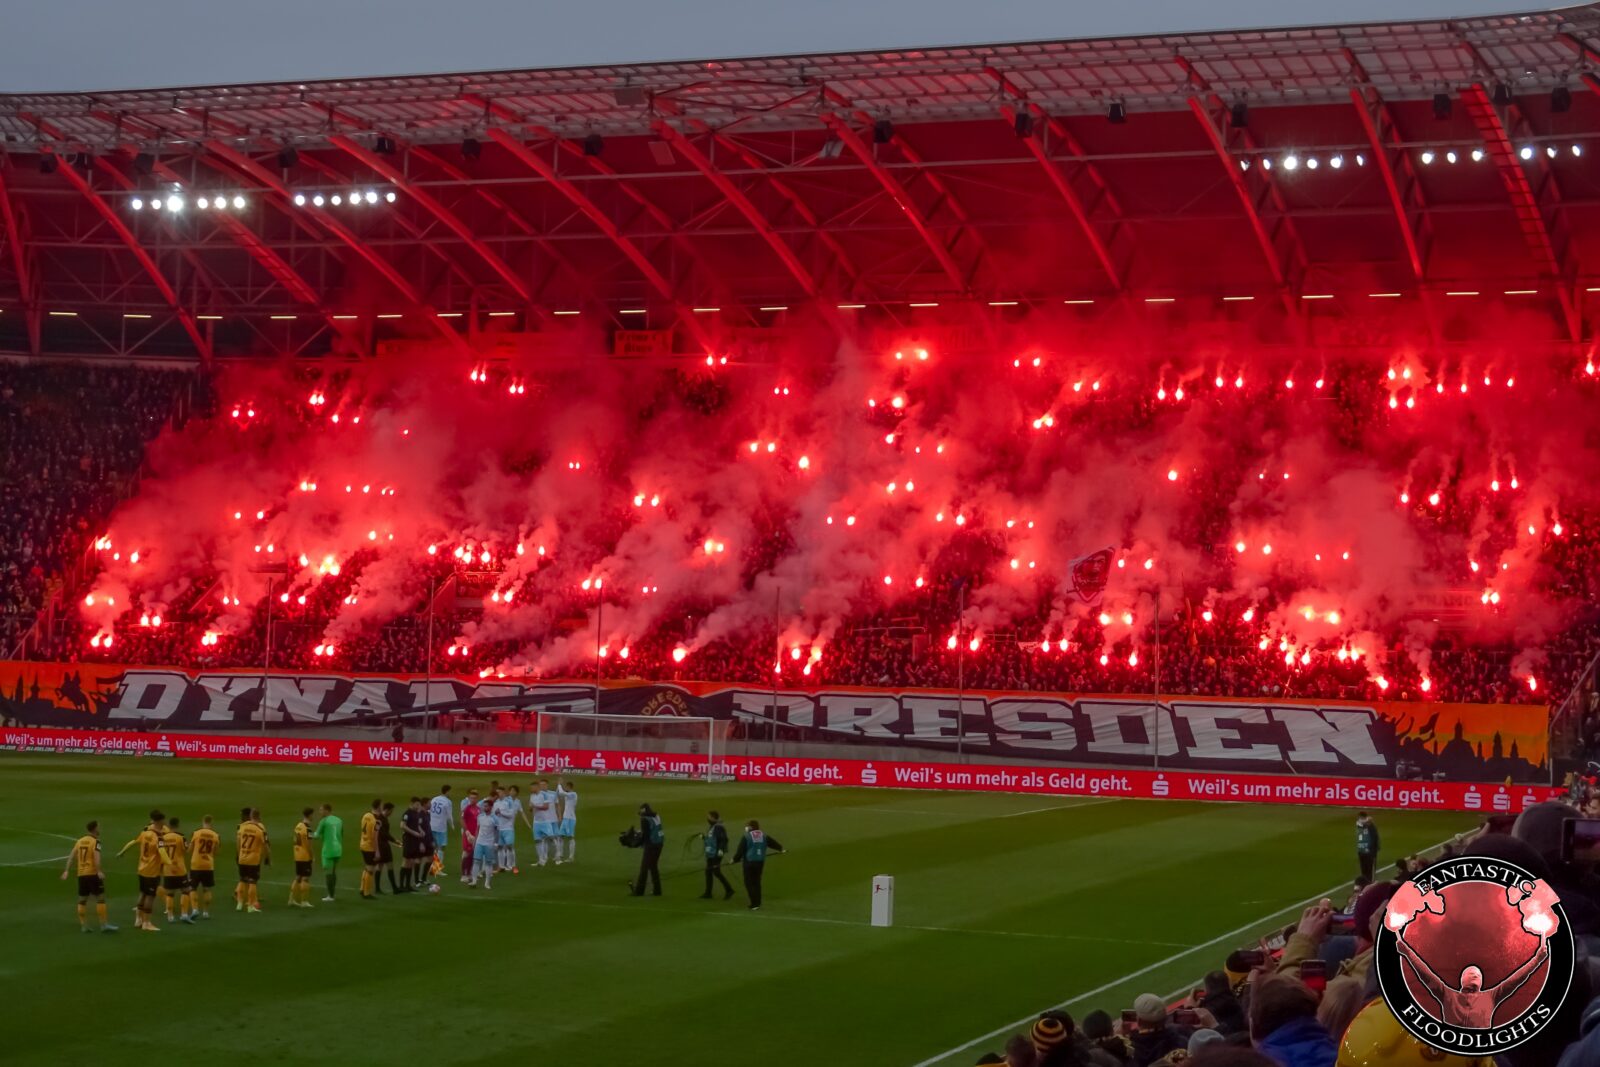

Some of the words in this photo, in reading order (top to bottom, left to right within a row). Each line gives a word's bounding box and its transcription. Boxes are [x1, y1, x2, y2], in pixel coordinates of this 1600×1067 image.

[732, 692, 1386, 766] DRESDEN
[5, 733, 35, 746] Weil's
[36, 736, 53, 747] um
[55, 736, 82, 748] mehr
[83, 737, 97, 749] als
[100, 738, 123, 749] Geld
[175, 739, 206, 752] Weil's
[209, 743, 226, 753] um
[228, 742, 256, 754] mehr
[258, 743, 273, 755] als
[275, 744, 299, 756] Geld
[301, 746, 329, 759] geht.
[368, 747, 410, 761] Weil's
[413, 752, 434, 762] um
[438, 750, 476, 764] mehr
[478, 751, 497, 765] als
[502, 752, 533, 767] Geld
[538, 754, 574, 769] geht.
[622, 756, 666, 772] Weil's
[671, 762, 694, 773] um
[698, 760, 737, 776] mehr
[740, 762, 761, 777] als
[765, 762, 799, 778] Geld
[803, 764, 843, 782] geht.
[895, 767, 942, 783] Weil's
[946, 773, 971, 784] um
[975, 771, 1017, 786] mehr
[1022, 772, 1045, 787] als
[1049, 774, 1085, 789] Geld
[1090, 775, 1132, 793] geht.
[1188, 779, 1240, 795] Weil's
[1244, 784, 1271, 797] um
[1276, 783, 1321, 798] mehr
[1325, 784, 1350, 800] als
[1354, 785, 1394, 801] Geld
[1399, 787, 1444, 806] geht.
[431, 801, 444, 815] 35
[241, 833, 256, 849] 27
[79, 846, 89, 863] 17
